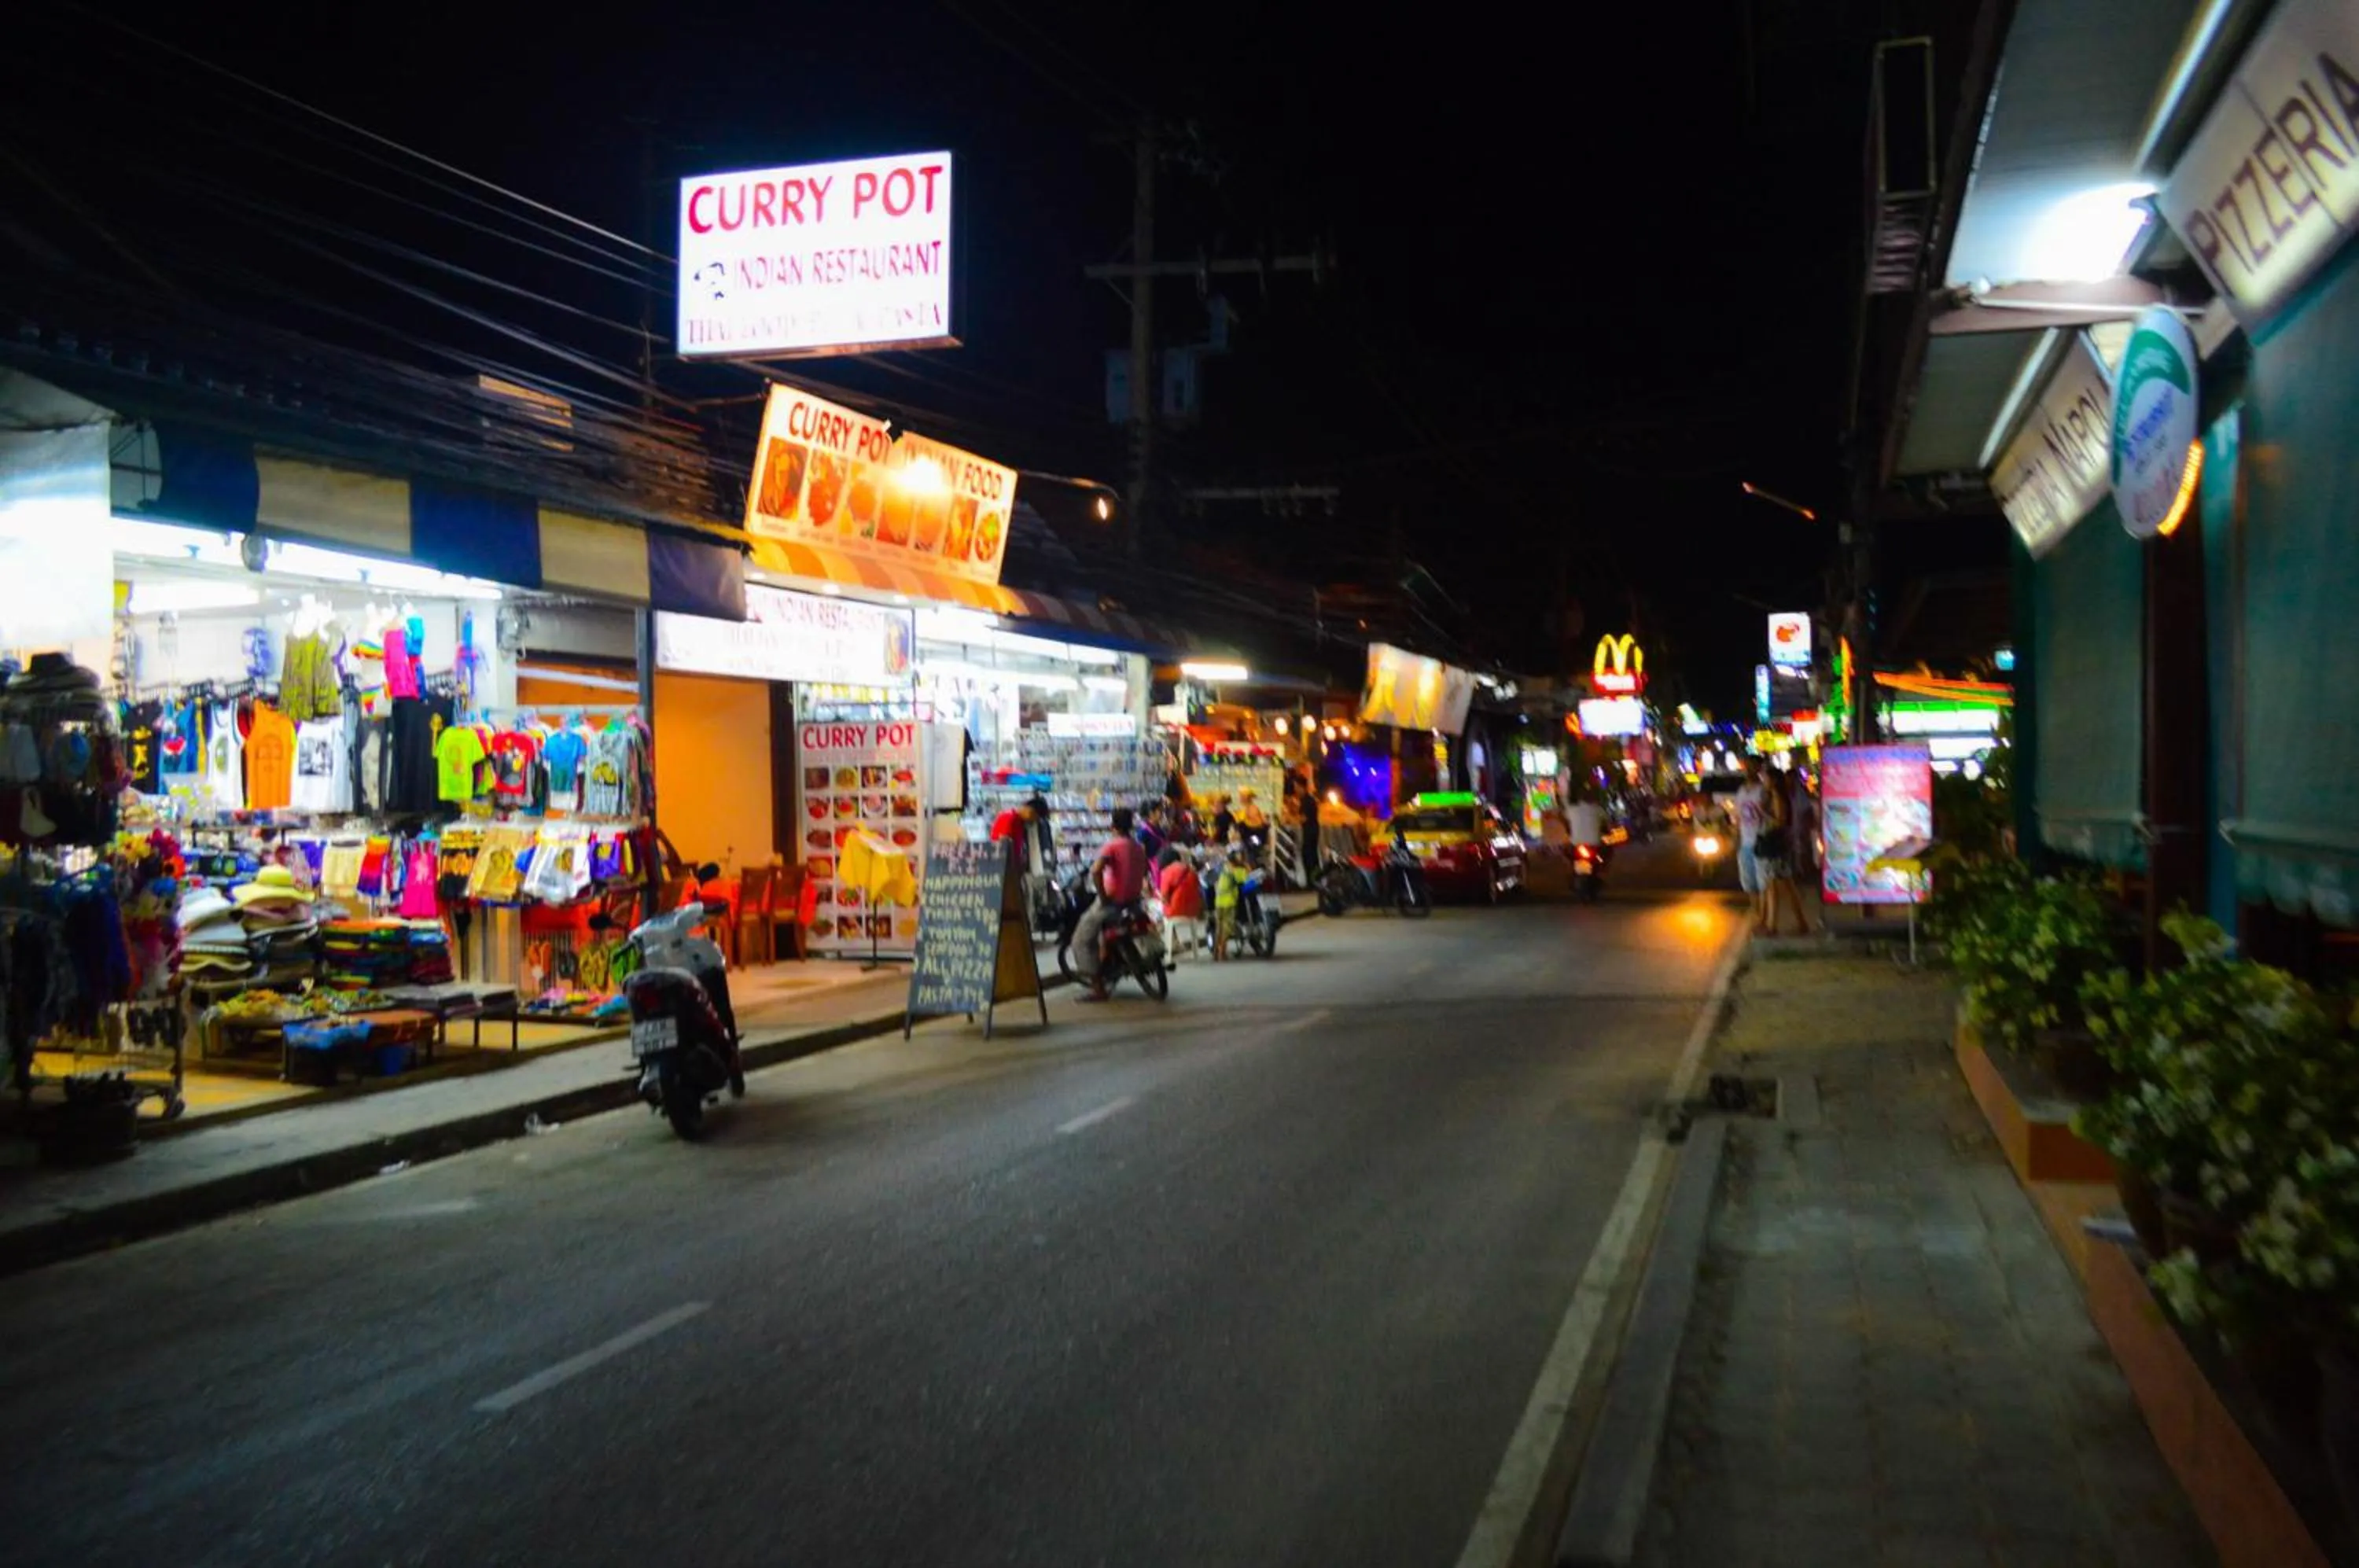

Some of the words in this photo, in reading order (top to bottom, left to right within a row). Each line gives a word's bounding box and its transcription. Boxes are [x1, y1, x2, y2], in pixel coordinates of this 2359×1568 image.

[687, 175, 833, 234] CURRY
[853, 165, 944, 219] POT
[2185, 52, 2359, 300] PIZZERIA
[734, 250, 804, 290] INDIAN
[812, 240, 942, 284] RESTAURANT
[789, 401, 855, 451] CURRY
[856, 425, 892, 465] POT
[962, 462, 1003, 500] FOOD
[803, 723, 868, 750] CURRY
[875, 722, 915, 747] POT
